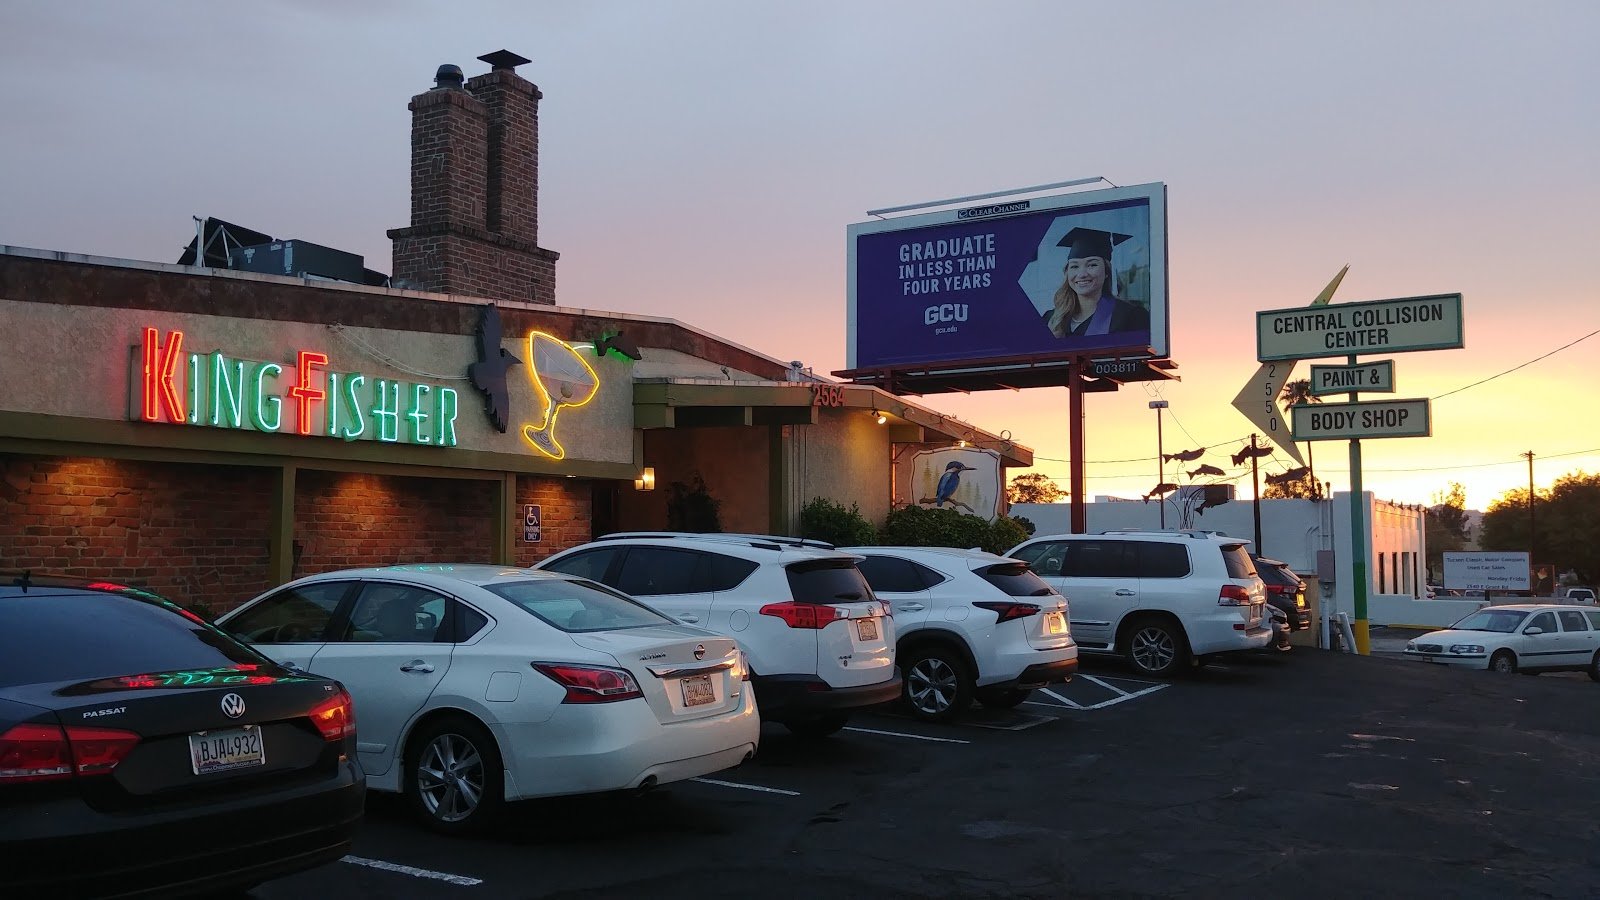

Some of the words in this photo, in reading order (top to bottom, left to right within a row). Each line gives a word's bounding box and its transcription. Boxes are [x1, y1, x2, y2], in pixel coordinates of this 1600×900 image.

[899, 233, 996, 263] GRADUATE
[898, 263, 915, 280] IN
[918, 259, 954, 278] LESS
[957, 254, 996, 273] THAN
[903, 278, 940, 296] FOUR
[943, 272, 992, 292] YEARS
[924, 303, 969, 326] GCU
[1273, 312, 1347, 335] CENTRAL
[1352, 303, 1444, 329] COLLISION
[935, 325, 958, 336] gcu.edu
[1324, 328, 1390, 349] CENTER
[1095, 362, 1137, 374] 003811
[1322, 369, 1365, 388] PAINT
[1369, 368, 1381, 386] &
[142, 327, 458, 448] KINGFISHER
[811, 383, 848, 408] 2564
[1311, 410, 1357, 432] BODY
[1361, 408, 1410, 429] SHOP
[525, 525, 540, 534] PARKING
[527, 532, 538, 540] ONLY
[82, 706, 128, 719] PASSAT
[200, 734, 259, 762] BJA4932
